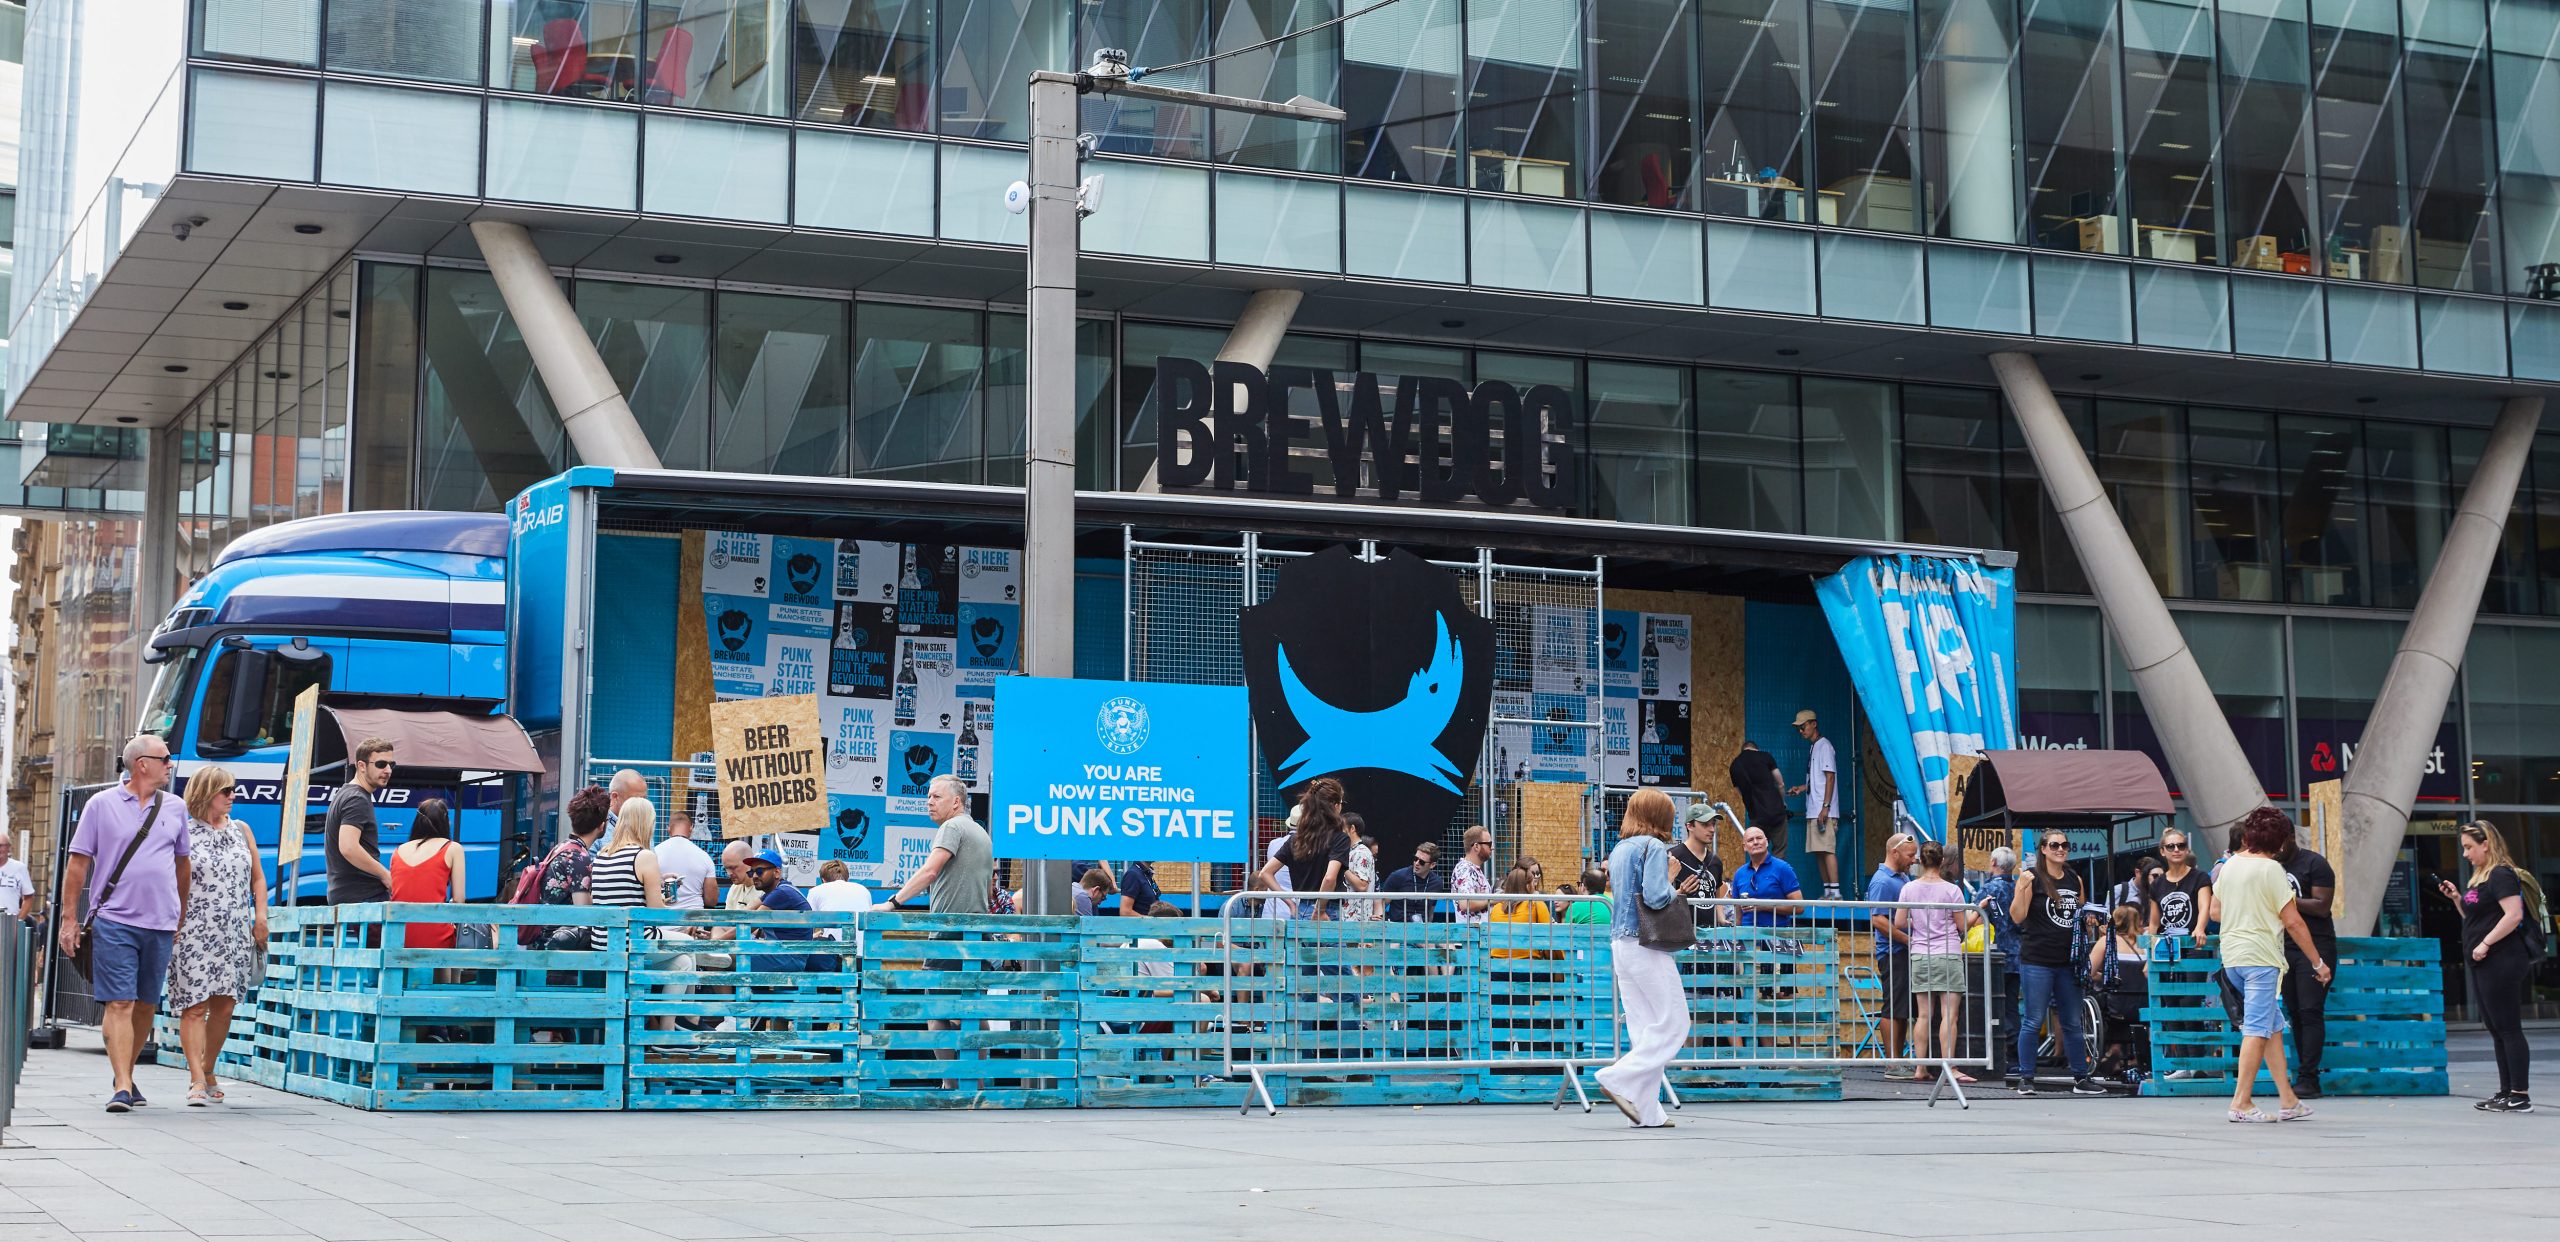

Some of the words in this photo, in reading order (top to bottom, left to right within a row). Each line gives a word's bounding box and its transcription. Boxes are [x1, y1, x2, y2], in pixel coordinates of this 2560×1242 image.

[1157, 356, 1575, 507] BREWDOG
[731, 541, 760, 557] HERE
[731, 556, 760, 564] MANCHESTER
[981, 551, 1009, 565] HERE
[783, 592, 820, 606] BREWDOG
[899, 590, 917, 601] THE
[918, 591, 939, 601] PUNK
[780, 607, 799, 615] PUNK
[800, 609, 822, 617] STATE
[899, 601, 926, 612] STATE
[928, 602, 939, 613] OF
[776, 613, 824, 623] MANCHESTER
[899, 612, 954, 625] MANCHESTER
[1669, 620, 1683, 628] STATE
[914, 643, 929, 652] PUNK
[930, 643, 947, 652] STATE
[714, 650, 750, 662] BREWDOG
[781, 646, 812, 663] PUNK
[833, 649, 860, 661] DRINK
[861, 652, 887, 664] PUNK.
[915, 652, 953, 661] MANCHESTER
[832, 661, 851, 672] JOIN
[853, 662, 870, 674] THE
[923, 661, 937, 670] HERE
[970, 657, 1004, 667] BREWDOG
[714, 671, 755, 680] ANCHESTER
[730, 666, 753, 674] STATE
[777, 663, 814, 679] STATE
[773, 679, 784, 692] IS
[831, 672, 886, 687] REVOLUTION.
[975, 704, 990, 712] PUNK
[1110, 699, 1137, 708] PUNK
[843, 708, 874, 724] PUNK
[840, 724, 875, 740] STATE
[977, 722, 983, 730] IS
[1604, 722, 1627, 735] TATE
[743, 724, 790, 751] BEER
[1607, 737, 1630, 750] HERE
[835, 739, 846, 754] IS
[849, 741, 877, 756] HERE
[1107, 742, 1139, 753] STATE
[1641, 744, 1662, 754] DRINK
[849, 755, 877, 763] MANCHESTER
[1641, 754, 1656, 764] JOIN
[1657, 755, 1671, 765] THE
[725, 750, 813, 782] WITHOUT
[1641, 764, 1686, 776] REVOLUTION.
[1083, 764, 1121, 781] YOU
[1125, 766, 1162, 782] ARE
[307, 785, 410, 803] CIB
[732, 778, 817, 810] BORDERS
[1049, 784, 1096, 800] NOW
[1100, 786, 1195, 803] ENTERING
[1008, 804, 1112, 836] PUNK
[1121, 808, 1235, 839] STATE
[791, 841, 808, 849] STATE
[902, 838, 931, 853] PUNK
[1961, 827, 2013, 851] WORD
[2080, 842, 2100, 853] 444
[833, 849, 868, 860] BREWDOG
[898, 854, 927, 868] STAT
